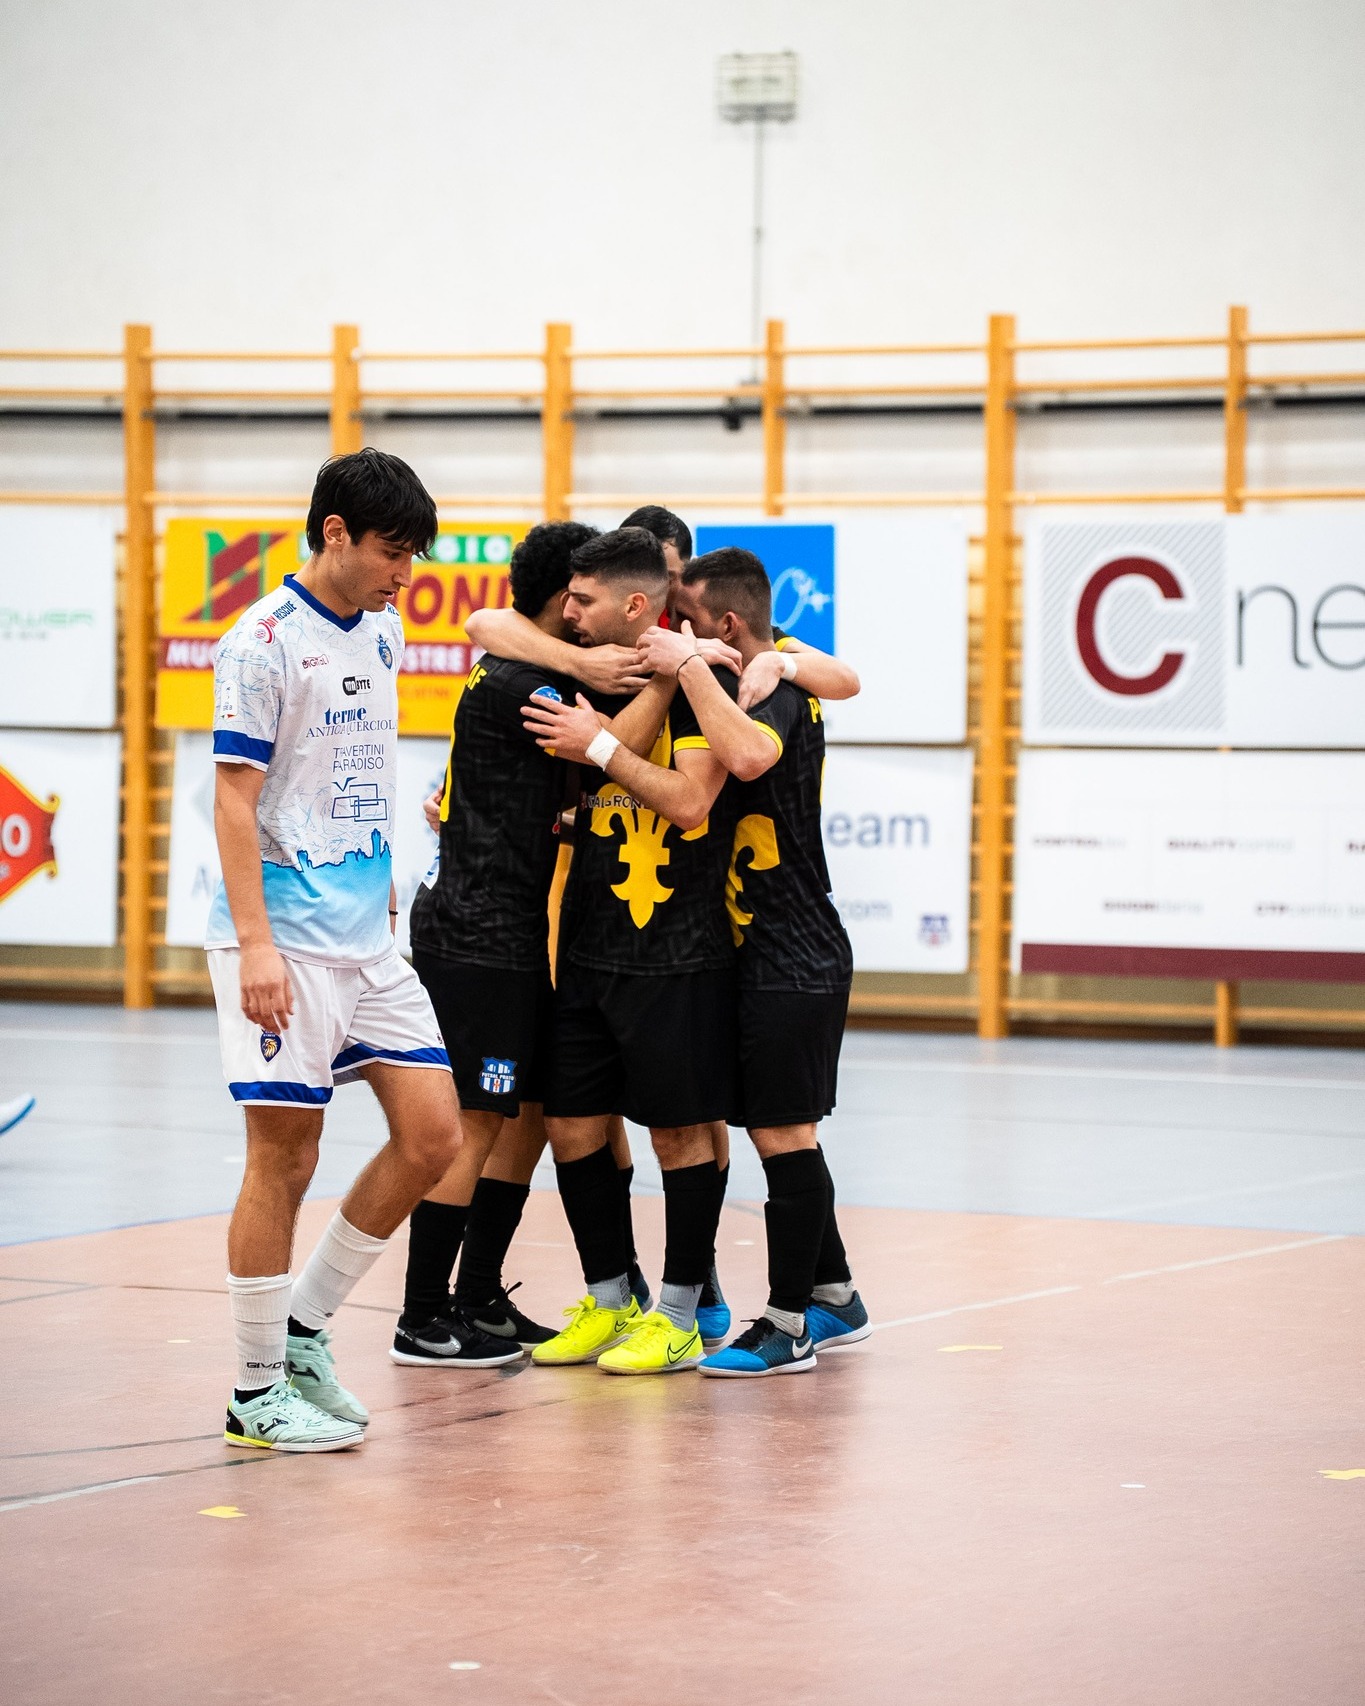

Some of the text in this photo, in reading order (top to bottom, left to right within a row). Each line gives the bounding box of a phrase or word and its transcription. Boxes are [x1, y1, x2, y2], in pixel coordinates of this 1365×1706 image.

[272, 600, 297, 621] RESCUE
[1077, 555, 1365, 697] C ne
[324, 707, 367, 726] terme
[333, 757, 384, 773] PARADISO
